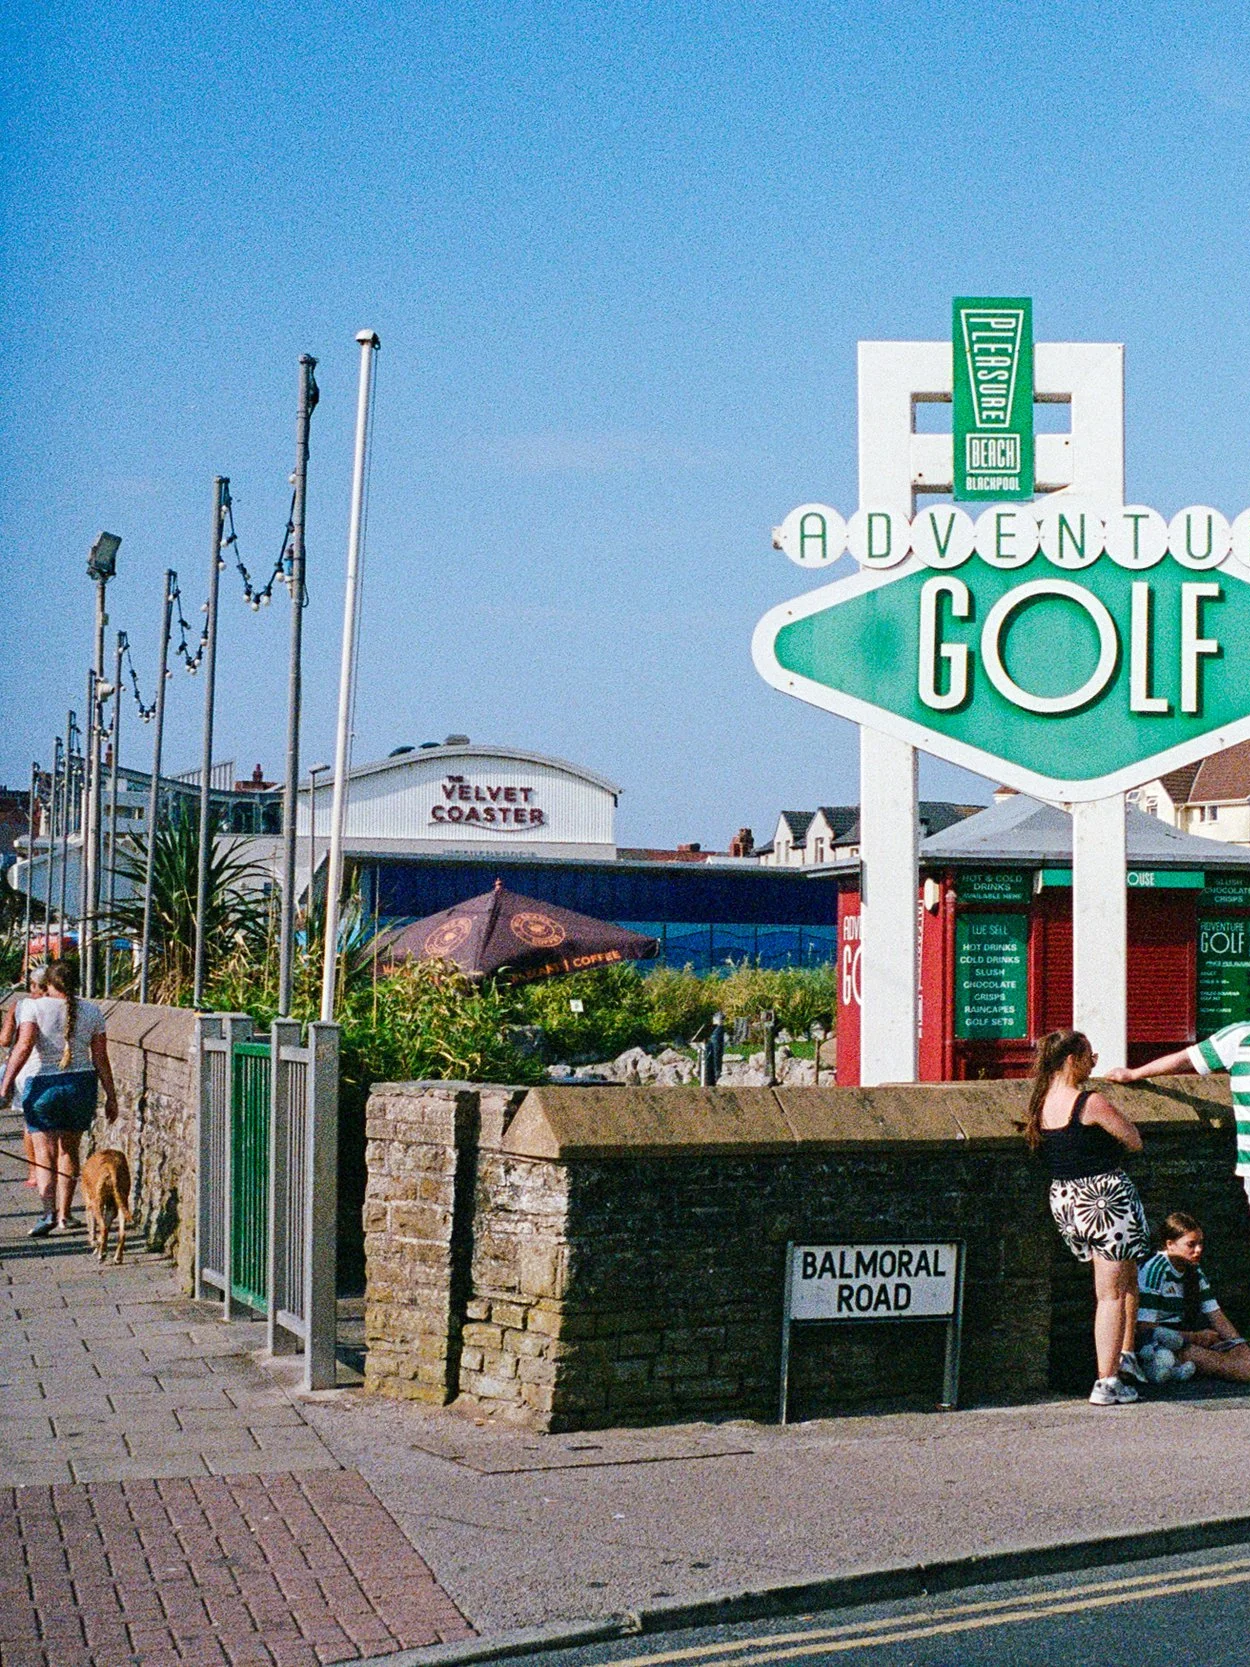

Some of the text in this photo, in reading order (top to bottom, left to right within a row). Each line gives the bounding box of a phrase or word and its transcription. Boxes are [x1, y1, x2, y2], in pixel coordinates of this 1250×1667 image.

[969, 317, 1017, 420] PLEASURE
[972, 439, 1015, 468] BEACH
[966, 476, 1021, 491] BLACKPOOL
[917, 576, 1220, 713] GOLF
[441, 784, 533, 802] VELVET
[431, 805, 546, 824] COASTER
[962, 874, 982, 882] HOT
[995, 874, 1023, 883] COLD
[1127, 871, 1155, 887] OUSE
[973, 883, 1012, 892] DRINKS
[972, 924, 1008, 936] WE SELL
[1200, 922, 1245, 932] ADVENTURE
[983, 944, 1018, 952] DRINKS
[1200, 931, 1245, 954] GOLF
[572, 950, 622, 968] COFFEE
[959, 956, 1021, 964] COLD DRINKS
[975, 968, 1006, 976] SLUSH
[963, 980, 1017, 989] CHOCOLATE
[973, 993, 1006, 1001] CRISPS
[964, 1005, 1016, 1014] RAINCAPES
[965, 1018, 1015, 1026] GOLF SETS
[801, 1250, 946, 1280] BALMORAL
[837, 1283, 912, 1312] ROAD
